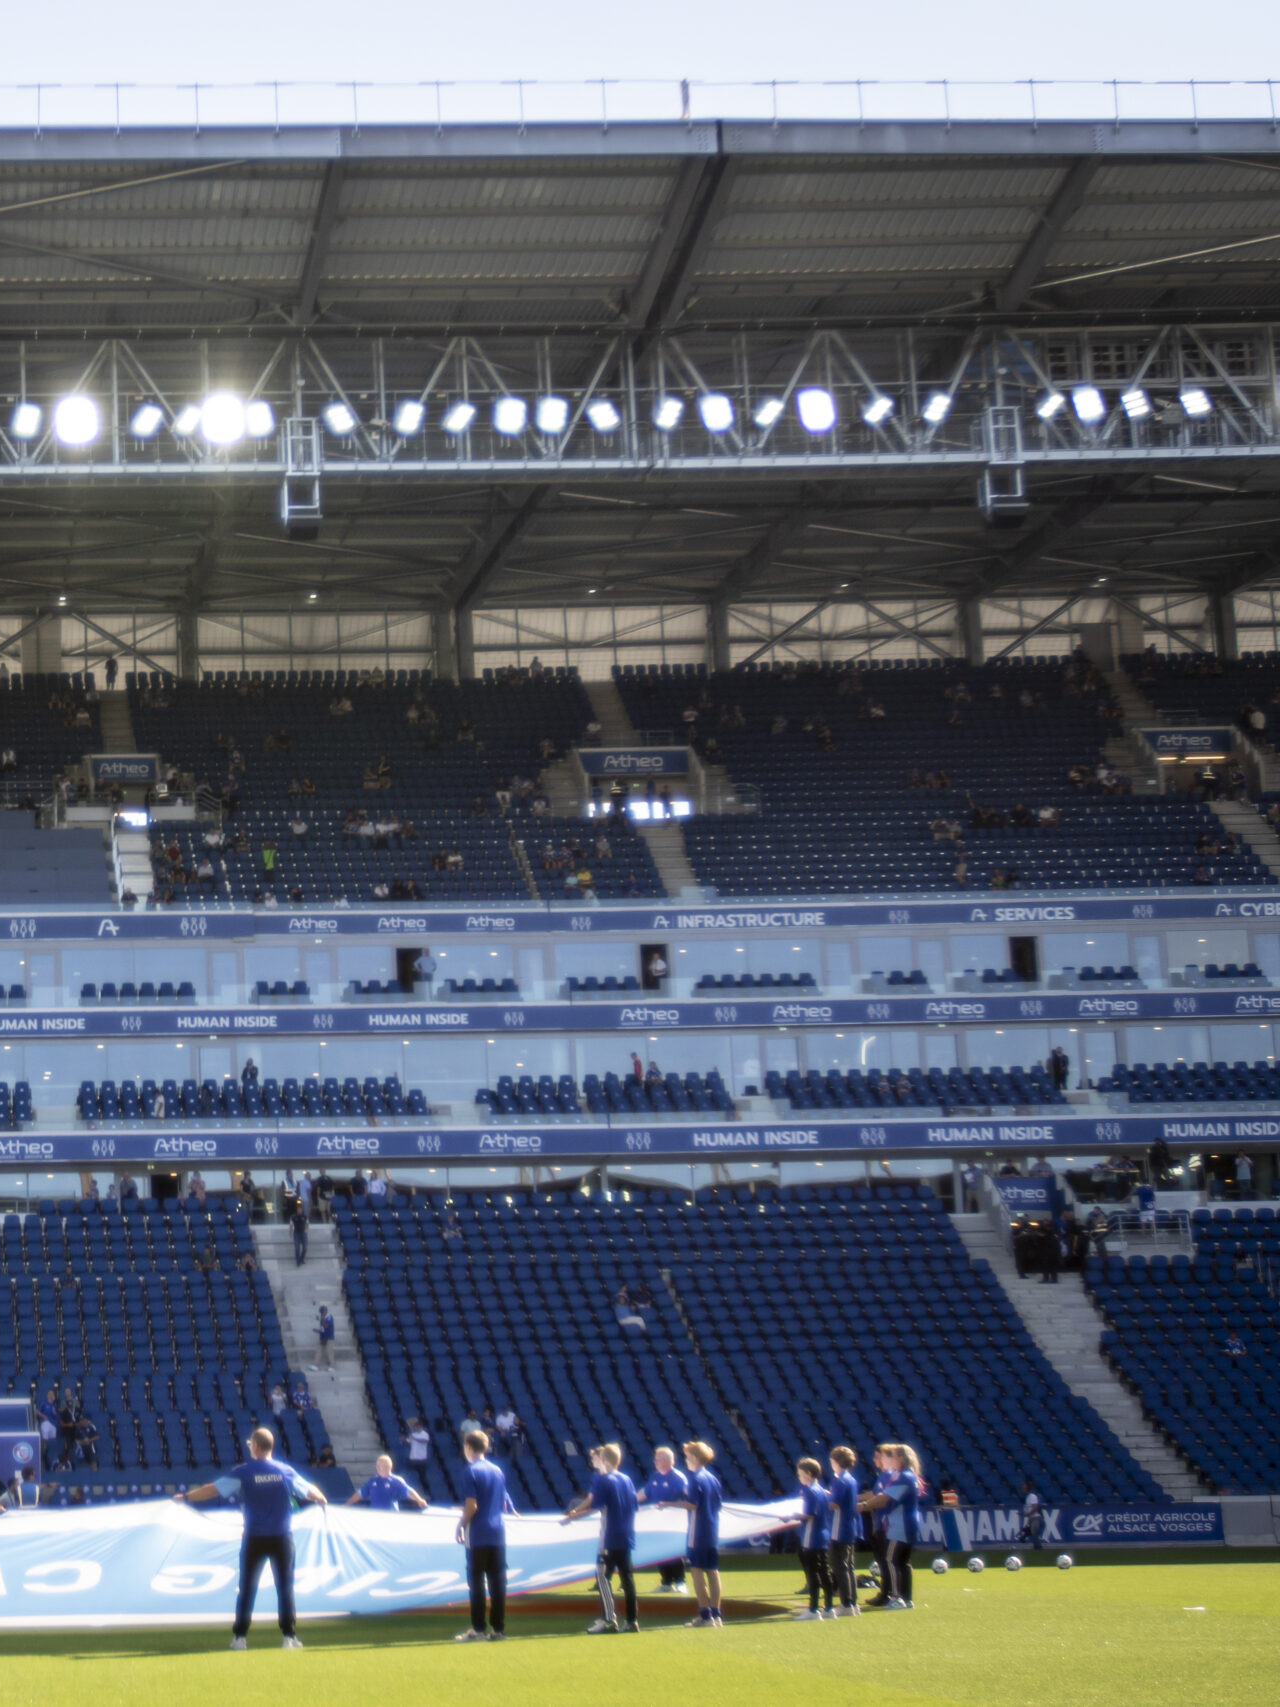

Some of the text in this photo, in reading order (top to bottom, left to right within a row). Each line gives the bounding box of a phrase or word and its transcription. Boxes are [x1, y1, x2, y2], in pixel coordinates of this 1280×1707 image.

[678, 912, 825, 928] INFRASTRUCTURE
[995, 906, 1075, 921] SERVICES
[289, 918, 337, 929] Atheo
[378, 917, 426, 928] Atheo
[466, 916, 514, 927] Atheo
[926, 1002, 984, 1015] Atheo
[1079, 998, 1138, 1011] Atheo
[621, 1008, 679, 1021] Atheo
[773, 1005, 832, 1018] Atheo
[42, 1018, 85, 1030] INSIDE
[177, 1016, 277, 1028] HUMAN INSIDE
[369, 1013, 468, 1026] HUMAN INSIDE
[928, 1126, 1053, 1141] HUMAN INSIDE
[1164, 1122, 1280, 1137] HUMAN INSID
[154, 1137, 216, 1151] Atheo
[317, 1136, 379, 1150] Atheo
[480, 1133, 541, 1147] Atheo
[693, 1131, 818, 1146] HUMAN INSIDE
[1106, 1512, 1150, 1522] CRÉDIT
[1154, 1512, 1216, 1522] AGRICOLE
[1107, 1522, 1213, 1533] ALSACE VOSGES
